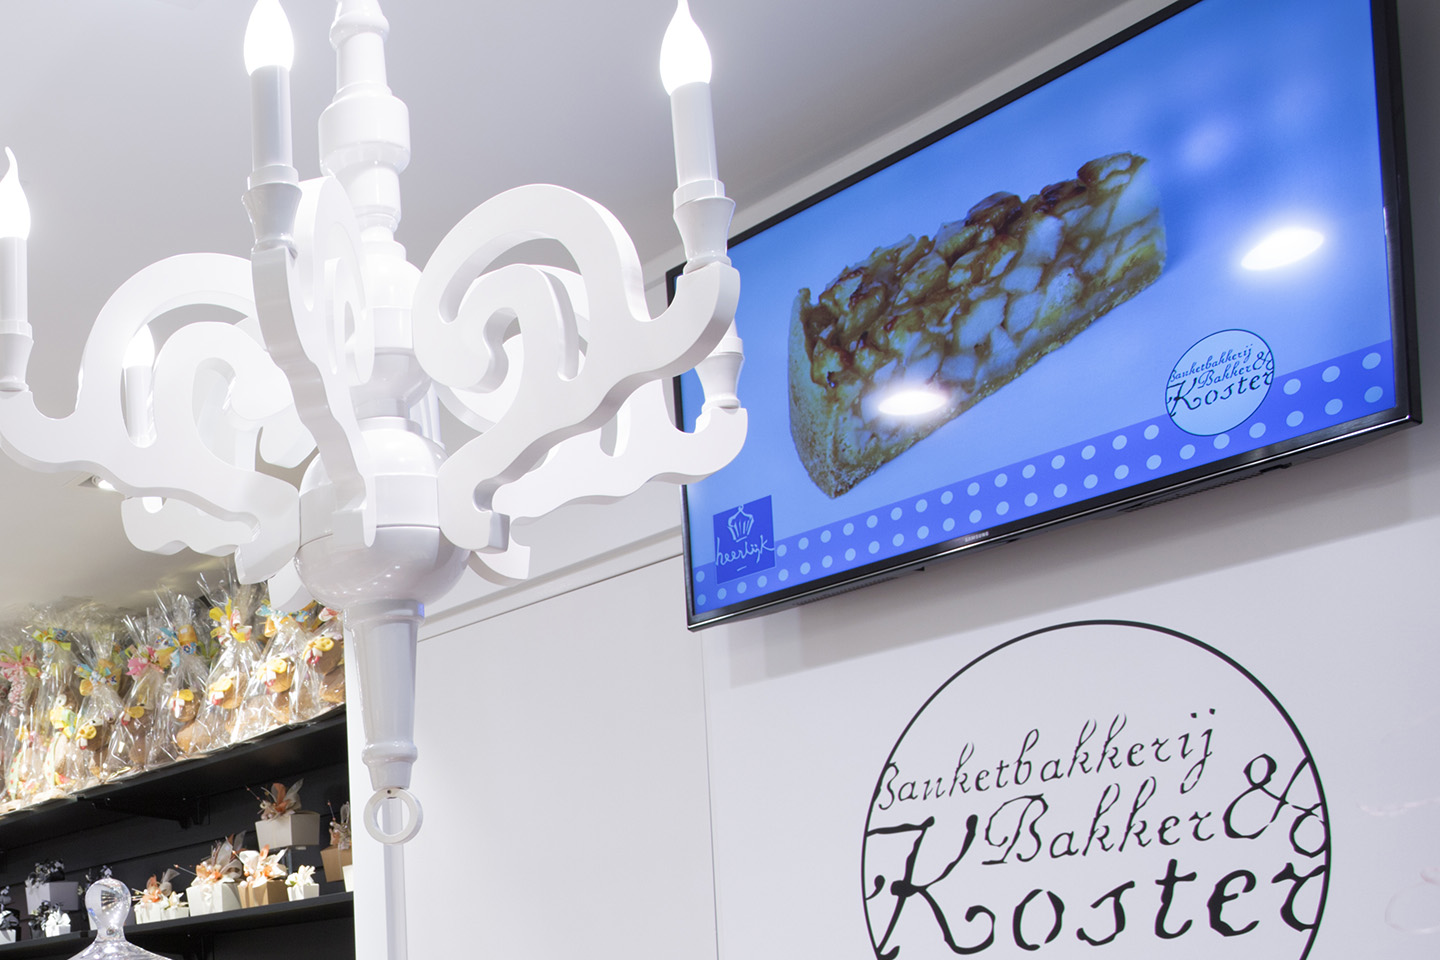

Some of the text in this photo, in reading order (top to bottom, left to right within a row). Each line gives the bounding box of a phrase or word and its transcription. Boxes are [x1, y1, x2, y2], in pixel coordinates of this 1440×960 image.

[1166, 371, 1274, 418] Koster
[981, 753, 1331, 866] Bakker &
